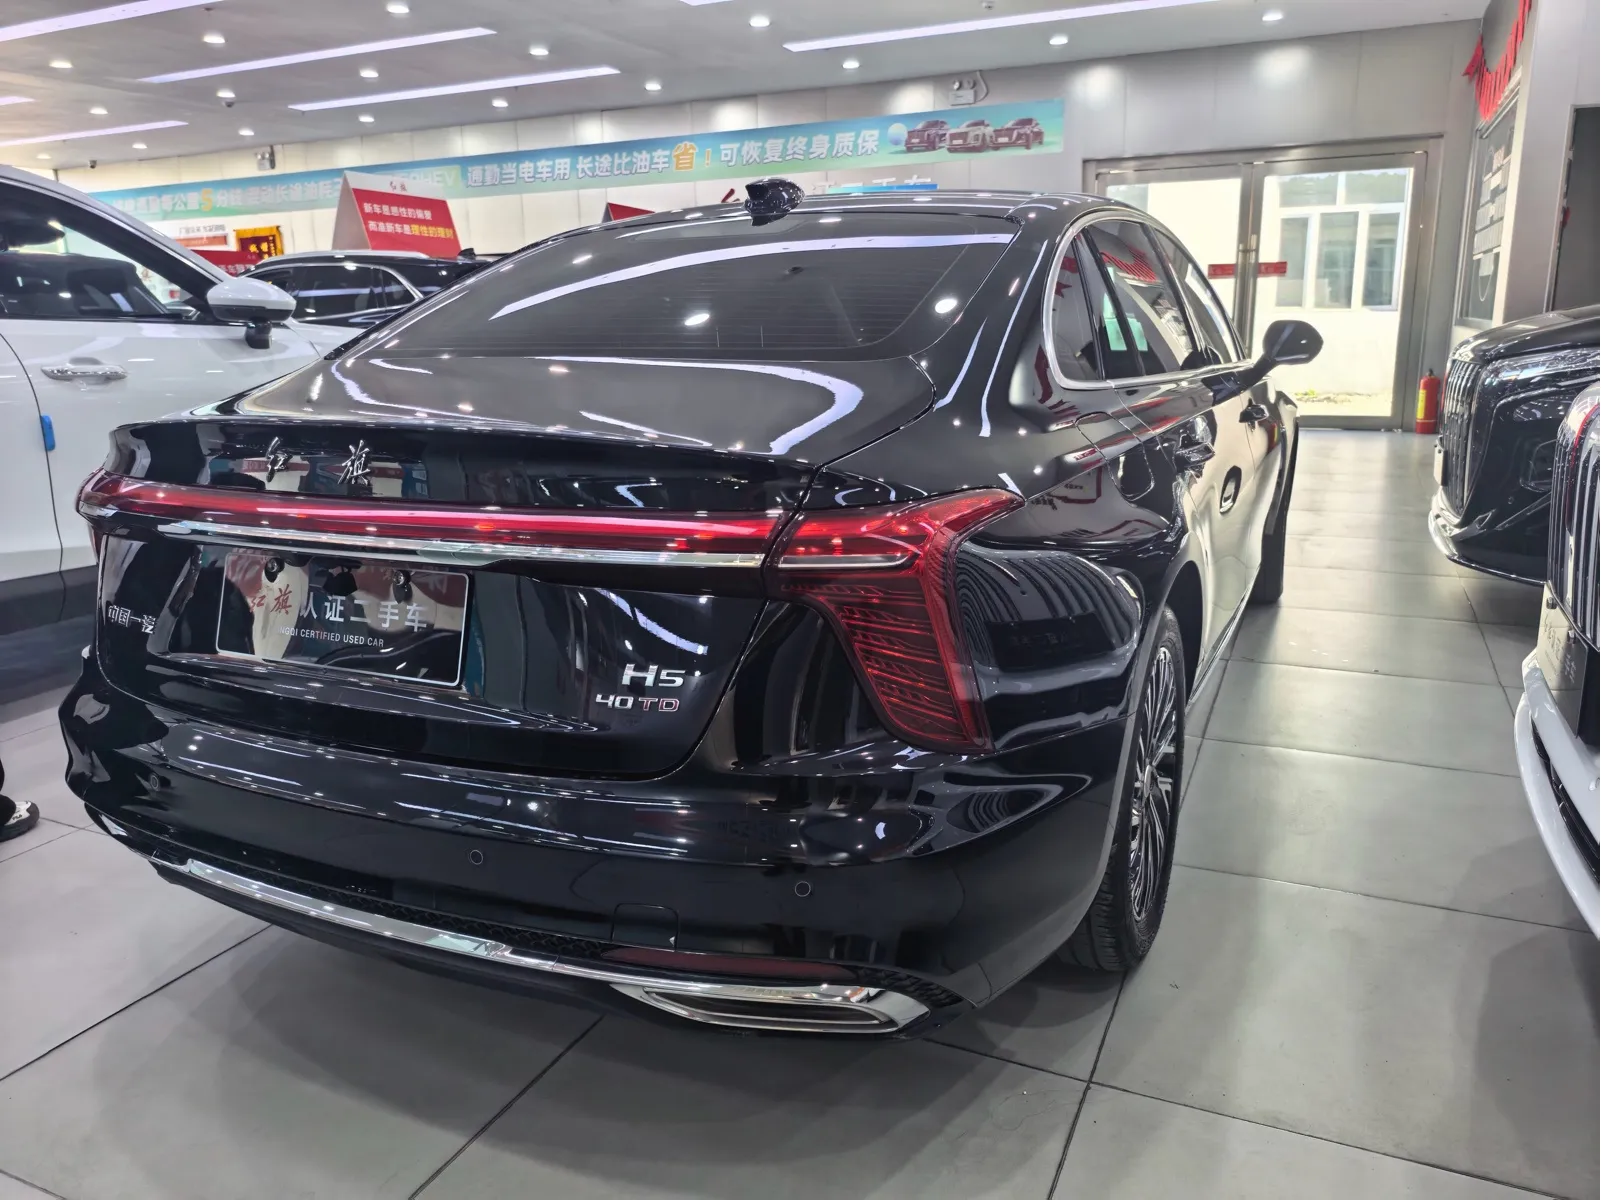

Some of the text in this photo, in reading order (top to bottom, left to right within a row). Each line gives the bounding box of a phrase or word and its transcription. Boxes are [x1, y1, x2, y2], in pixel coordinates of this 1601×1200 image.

[467, 158, 570, 188] 通勤当电车用
[719, 129, 880, 167] 可恢复终身质保
[300, 628, 341, 642] CERTIFIED
[343, 634, 365, 646] USED
[367, 637, 385, 648] CAR
[621, 663, 686, 687] H5
